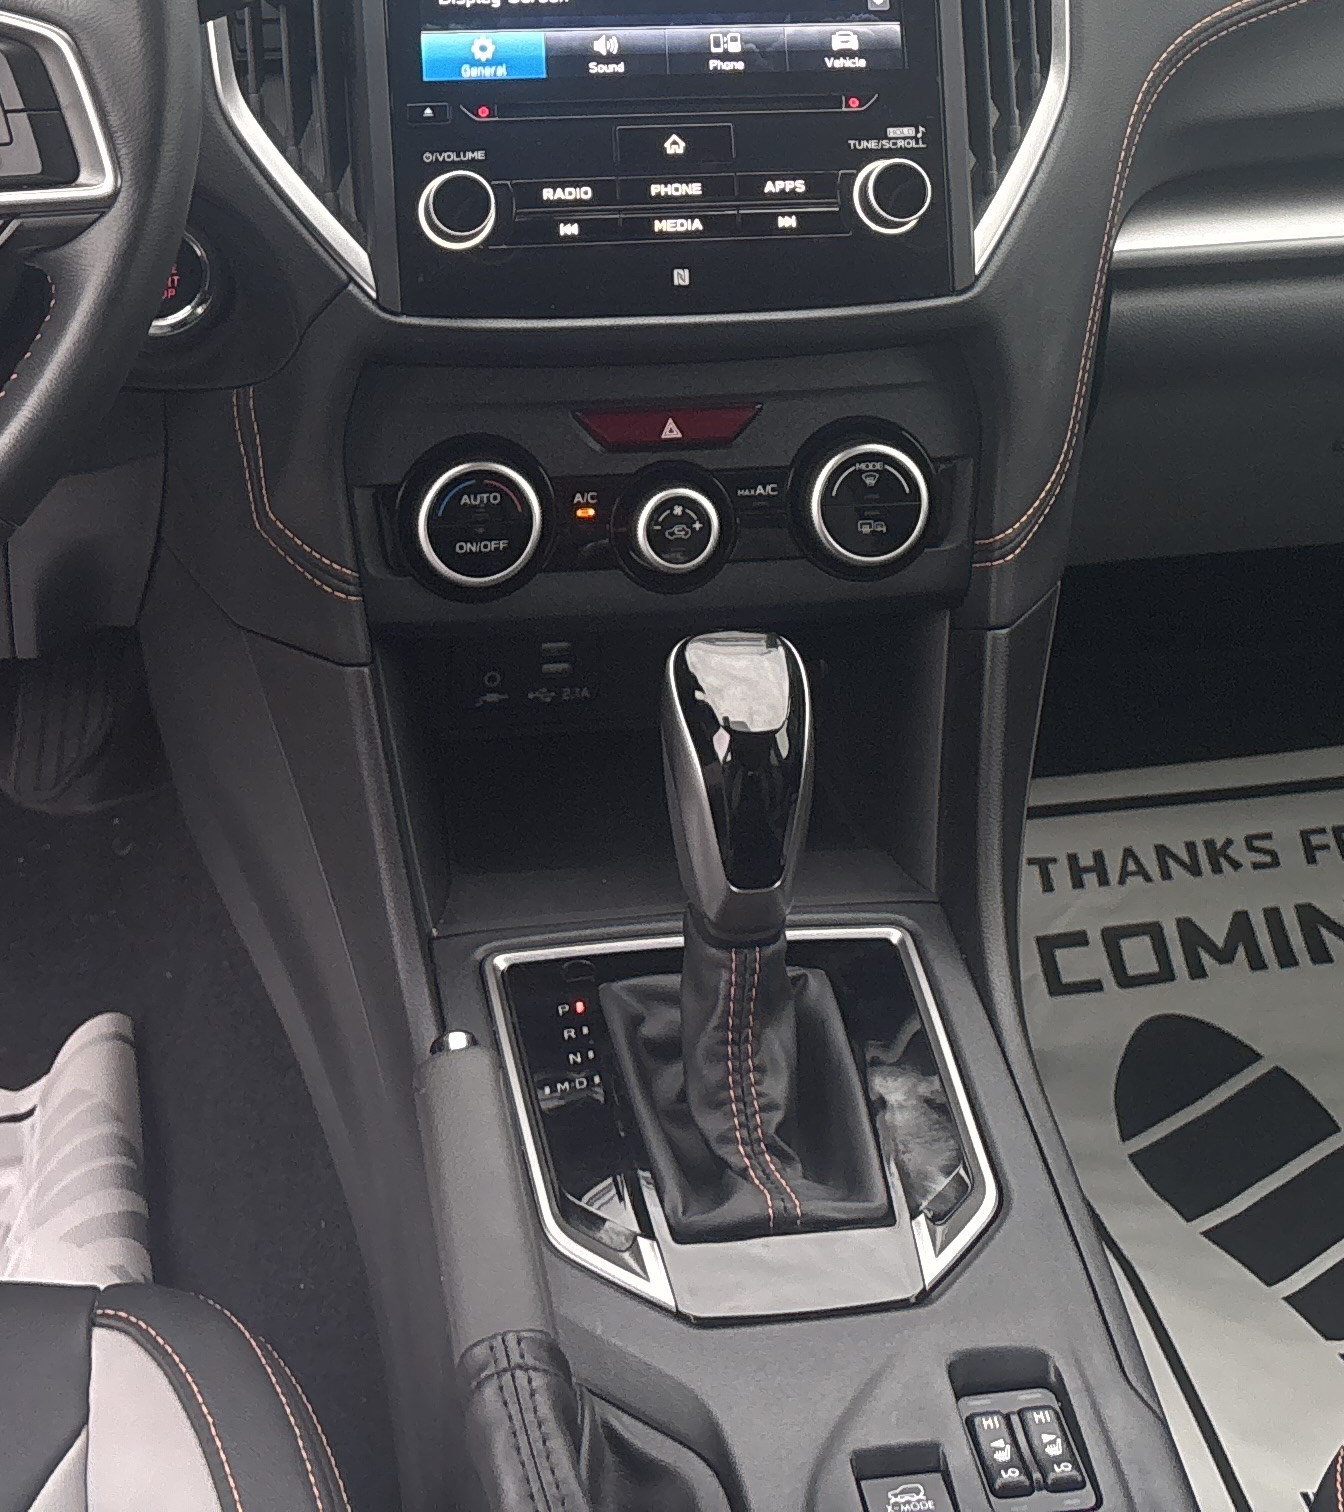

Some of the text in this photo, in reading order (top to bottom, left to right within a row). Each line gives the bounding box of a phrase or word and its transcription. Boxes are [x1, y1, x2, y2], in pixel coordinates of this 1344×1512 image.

[588, 60, 625, 74] Sound
[708, 58, 745, 72] Phone
[824, 56, 866, 69] Vehicle
[461, 64, 507, 78] General
[847, 138, 927, 149] TUNE/SCROLL
[650, 182, 702, 197] PHONE
[764, 178, 806, 194] APPS
[542, 186, 592, 201] RADIO
[654, 218, 703, 234] MEDIA
[855, 461, 884, 471] MODE
[755, 483, 778, 496] A/C
[460, 492, 502, 506] AUTO
[573, 491, 598, 504] A/C
[455, 539, 509, 554] ON/OFF
[1027, 831, 1281, 893] THANKS
[557, 1004, 570, 1017] P
[563, 1028, 576, 1041] R
[568, 1051, 582, 1065] N
[981, 1415, 1000, 1430] HI
[1033, 1410, 1051, 1425] HI
[1000, 1467, 1020, 1479] LO
[1054, 1461, 1073, 1473] LO
[886, 1499, 935, 1512] X-MODE
